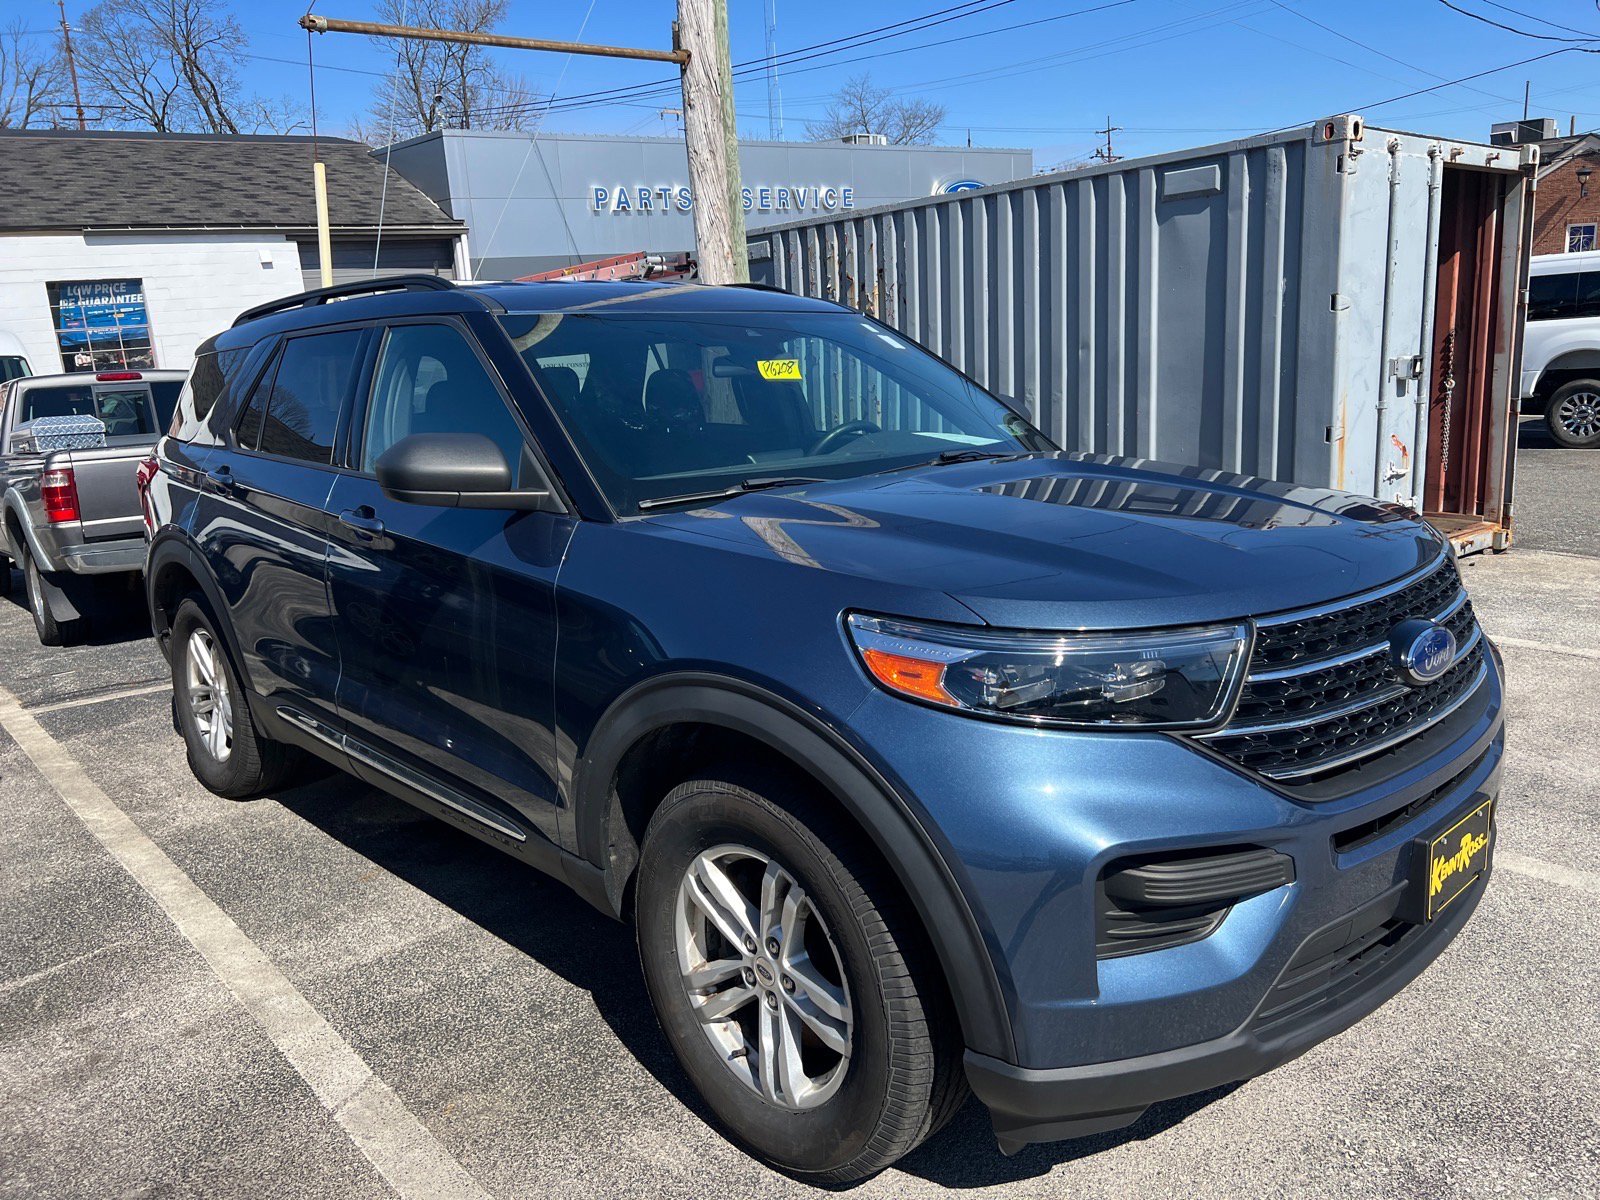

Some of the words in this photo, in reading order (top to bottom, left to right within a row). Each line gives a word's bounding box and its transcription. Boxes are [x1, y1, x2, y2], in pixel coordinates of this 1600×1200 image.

[593, 186, 693, 211] PARTS
[741, 186, 855, 210] SERVICE
[78, 293, 144, 308] GUARANTEE
[1424, 641, 1450, 671] Ford
